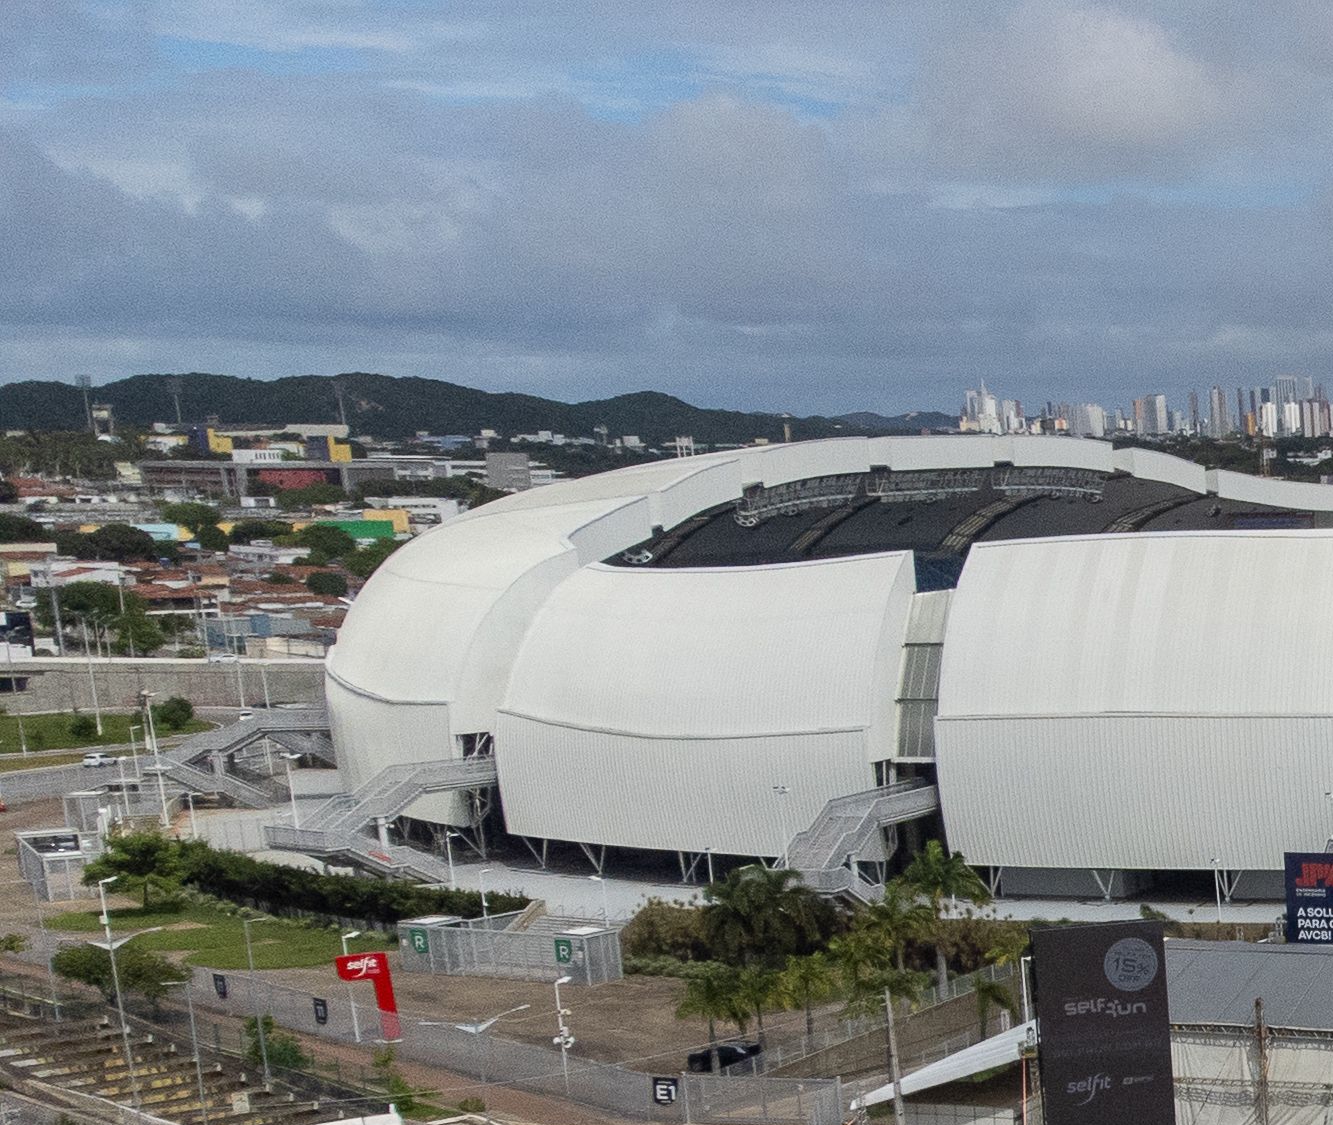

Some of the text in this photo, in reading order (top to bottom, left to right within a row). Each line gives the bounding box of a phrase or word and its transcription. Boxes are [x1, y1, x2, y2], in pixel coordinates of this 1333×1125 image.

[1297, 907, 1306, 918] A
[1297, 919, 1327, 929] PARA
[414, 935, 424, 948] R
[1298, 930, 1332, 941] AVCB!
[559, 945, 569, 958] R
[1113, 957, 1149, 976] 15%
[656, 1084, 676, 1100] E1
[1066, 1071, 1112, 1106] selfit
